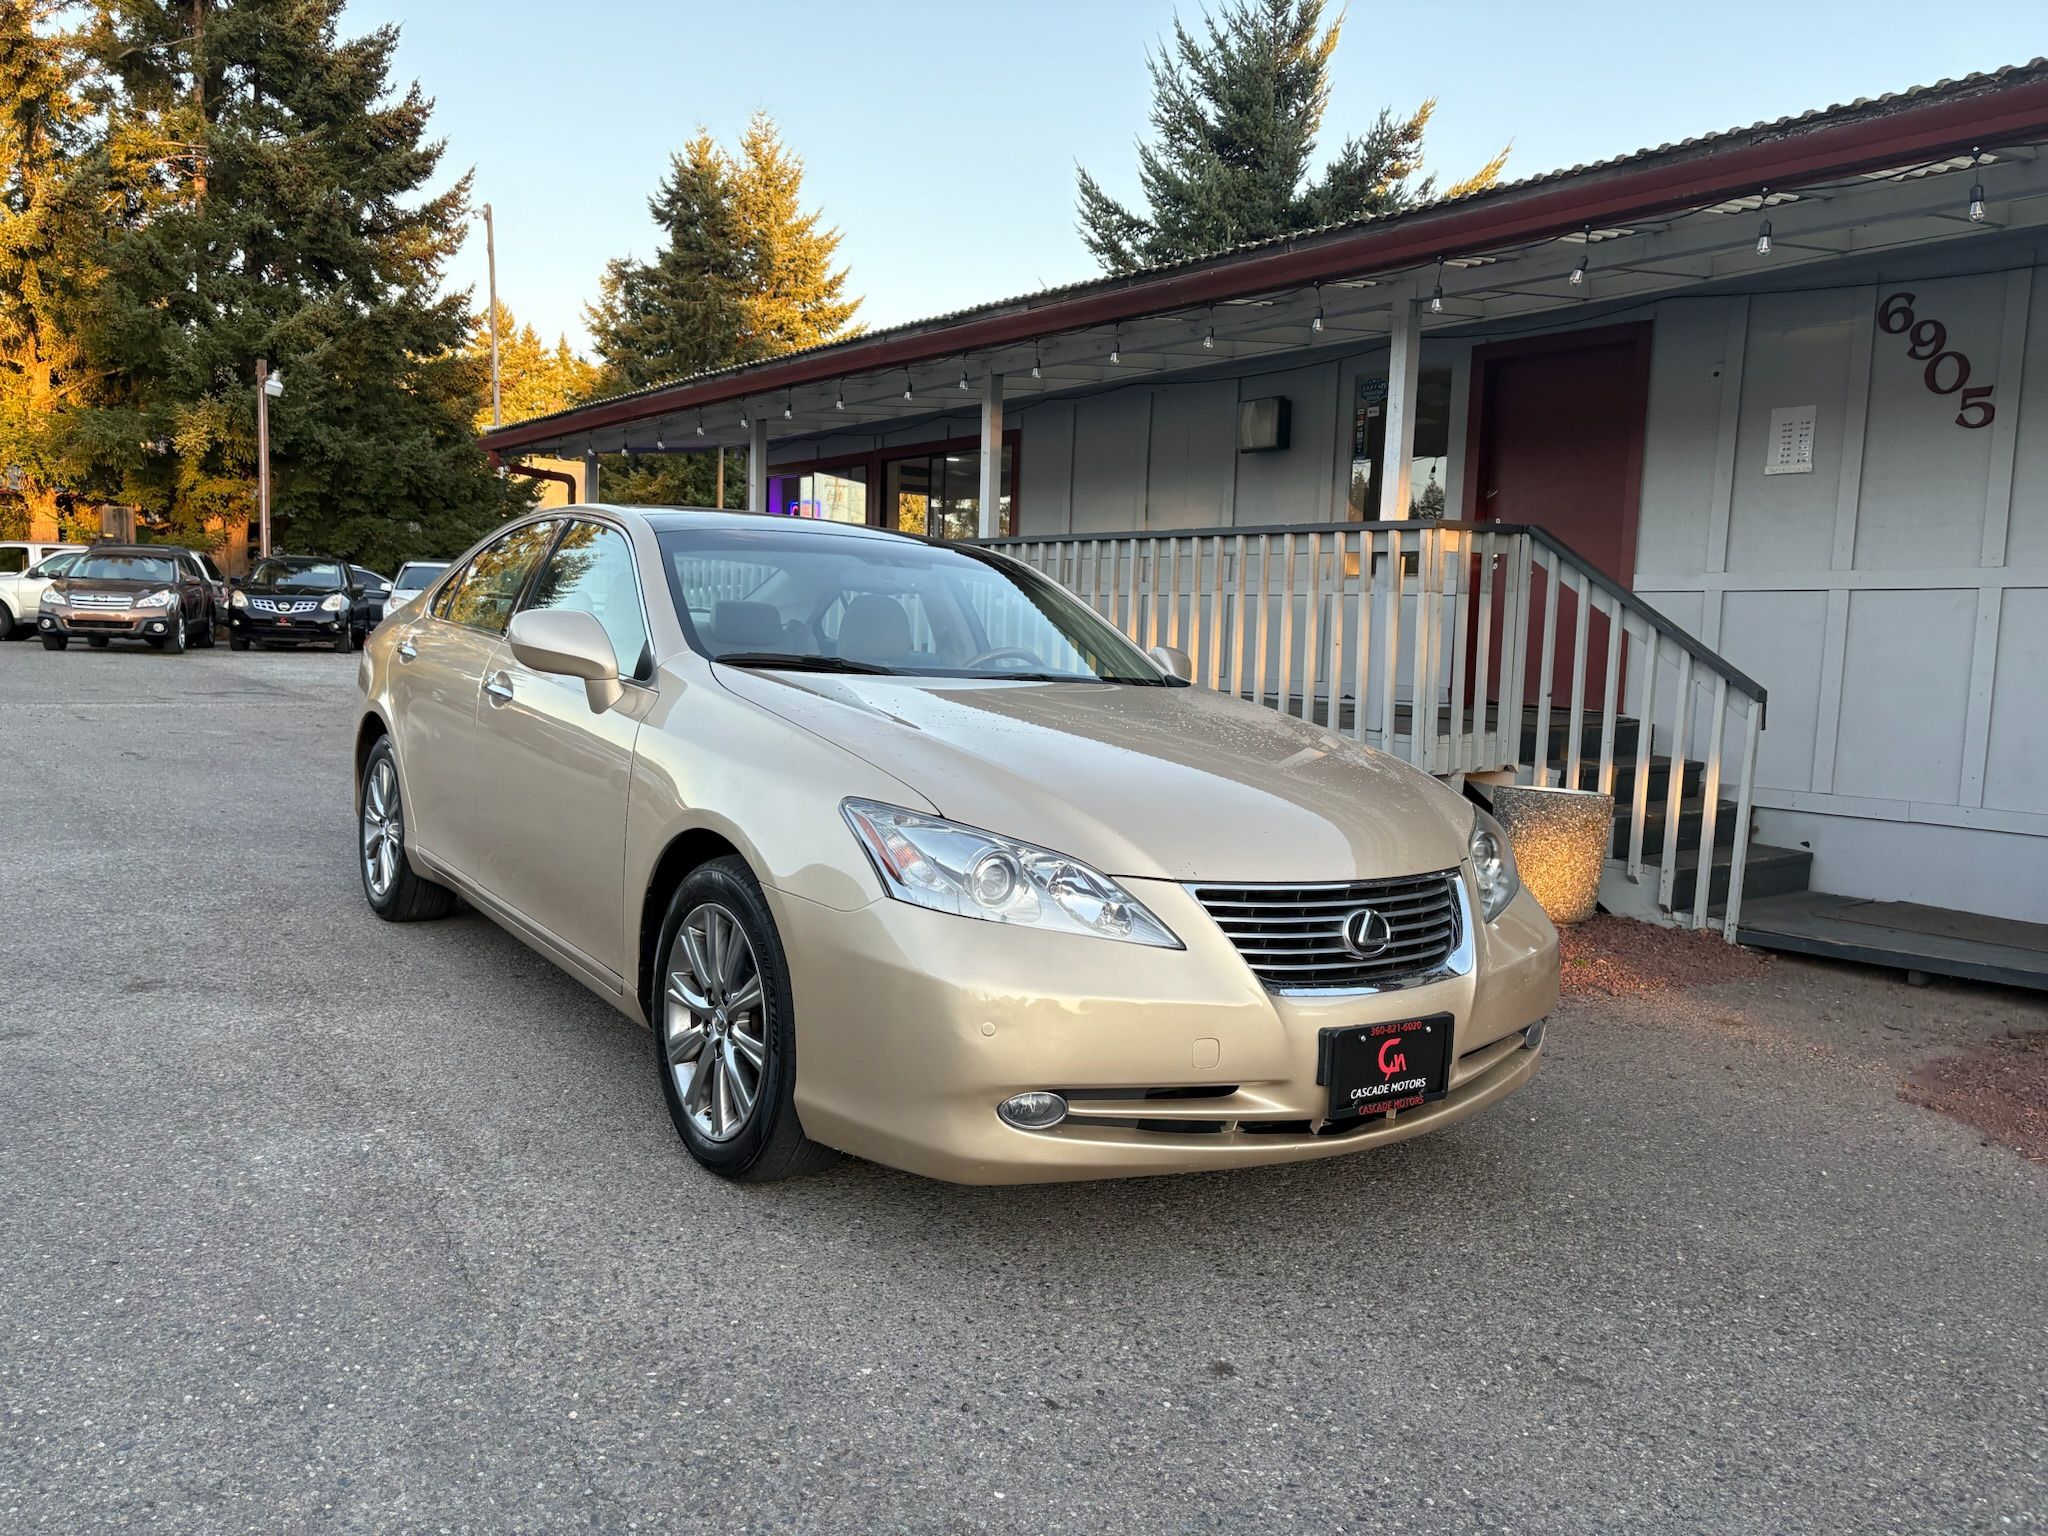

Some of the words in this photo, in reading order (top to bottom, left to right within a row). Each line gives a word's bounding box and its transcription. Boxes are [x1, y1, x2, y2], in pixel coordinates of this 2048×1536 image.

[1878, 292, 1996, 429] 6905
[1370, 1021, 1422, 1036] 360-821-6020
[1350, 1083, 1390, 1099] CASCADE
[1390, 1077, 1427, 1092] MOTORS
[1358, 1101, 1393, 1115] CASCADE
[1393, 1096, 1424, 1110] MOTORS
